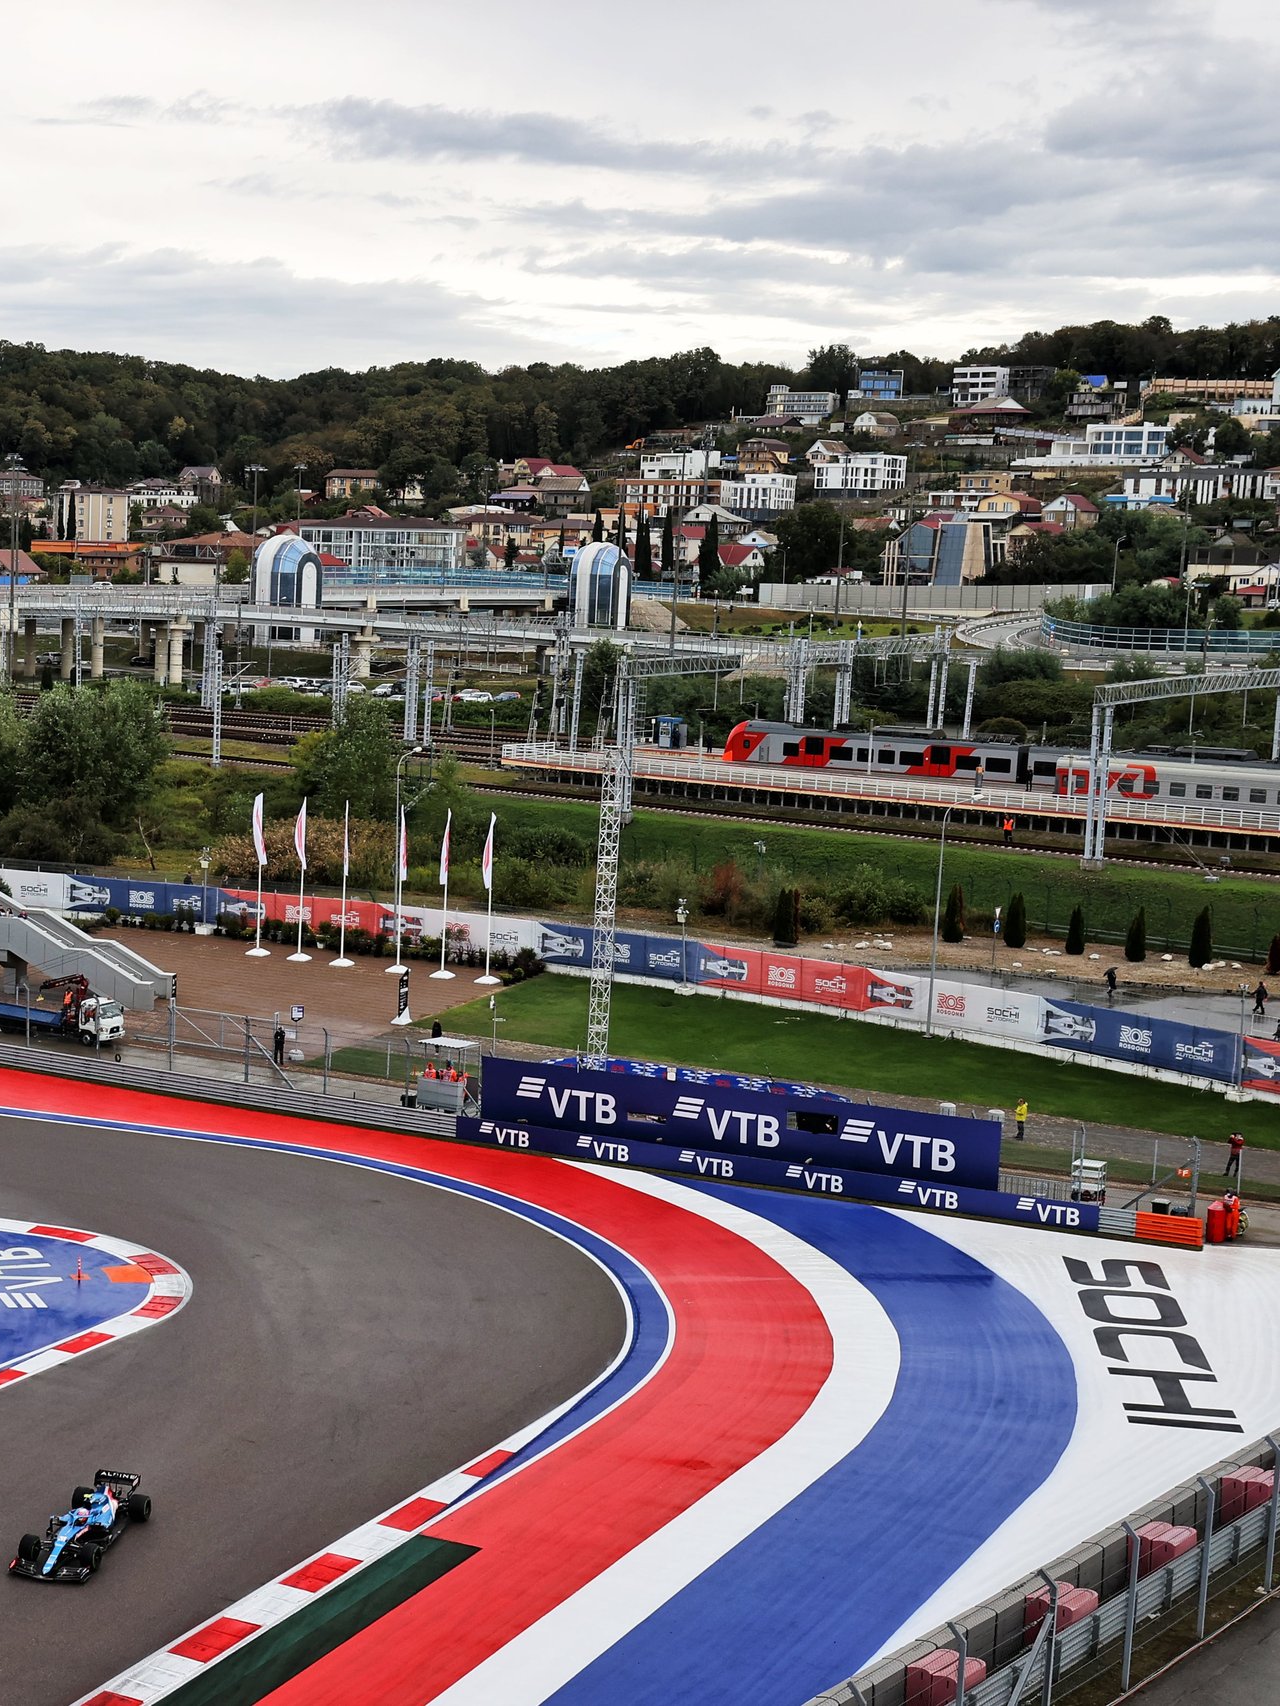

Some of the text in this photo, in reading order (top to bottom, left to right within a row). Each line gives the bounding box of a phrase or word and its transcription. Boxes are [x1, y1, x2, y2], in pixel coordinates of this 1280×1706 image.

[129, 890, 154, 904] ROS
[490, 932, 518, 941] SOCHI
[649, 953, 680, 963] SOCHI
[768, 965, 795, 983] ROS
[815, 979, 846, 989] SOCHI
[937, 993, 966, 1011] ROS
[987, 1007, 1019, 1019] SOCHI
[1120, 1025, 1152, 1047] ROS
[1119, 1043, 1151, 1054] ROSGONKI
[1175, 1052, 1213, 1063] AUTODROM
[1176, 1043, 1214, 1058] SOCHI
[548, 1086, 617, 1125] VTB
[706, 1107, 780, 1148] VTB
[495, 1127, 529, 1148] VTB
[593, 1141, 629, 1162] VTB
[877, 1130, 956, 1173] VTB
[696, 1157, 734, 1178] VTB
[804, 1171, 843, 1193] VTB
[918, 1187, 958, 1210] VTB
[1036, 1203, 1080, 1227] VTB
[1062, 1256, 1244, 1433] SOCHI
[100, 1471, 138, 1480] ALPINE
